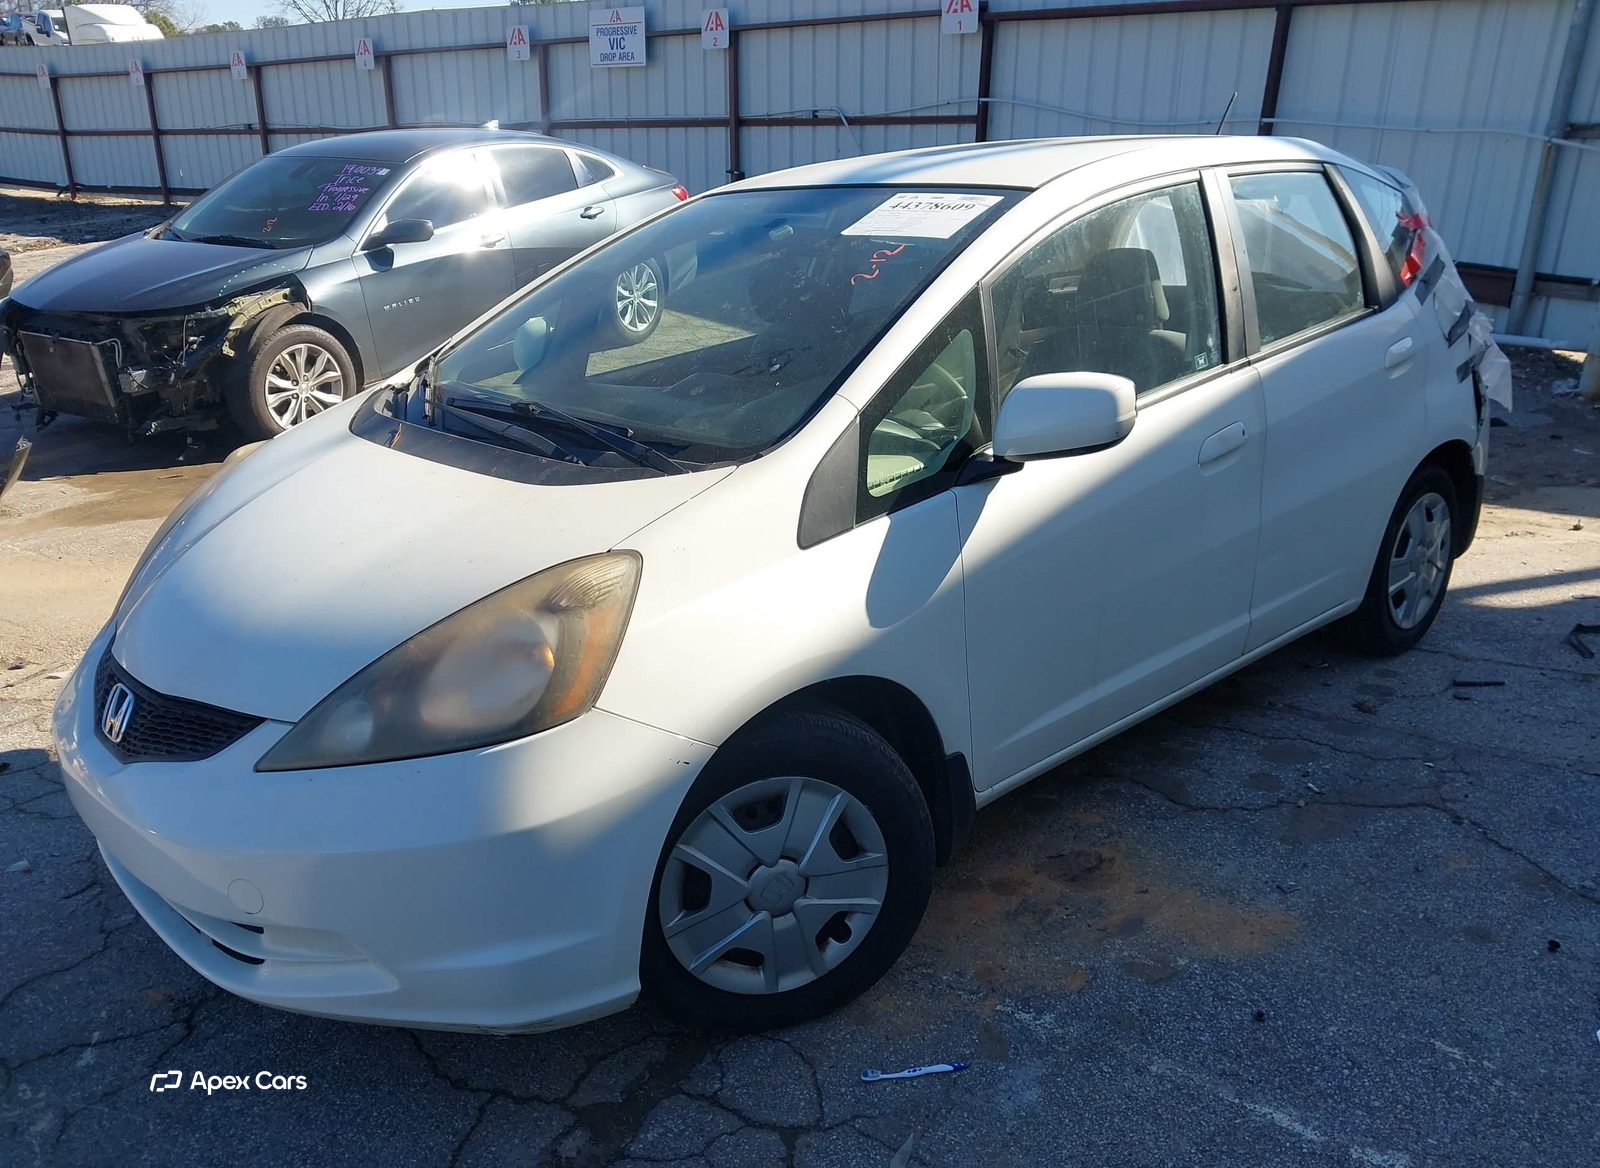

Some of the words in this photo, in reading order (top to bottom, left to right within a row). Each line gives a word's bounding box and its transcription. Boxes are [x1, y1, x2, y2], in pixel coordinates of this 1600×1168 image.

[595, 25, 638, 37] PROGRESSIVE
[957, 20, 962, 31] 1
[608, 36, 626, 51] VIC
[712, 36, 718, 47] 2
[516, 50, 521, 59] 3
[600, 52, 617, 62] DROP
[618, 51, 635, 61] AREA
[889, 201, 976, 211] 44378609
